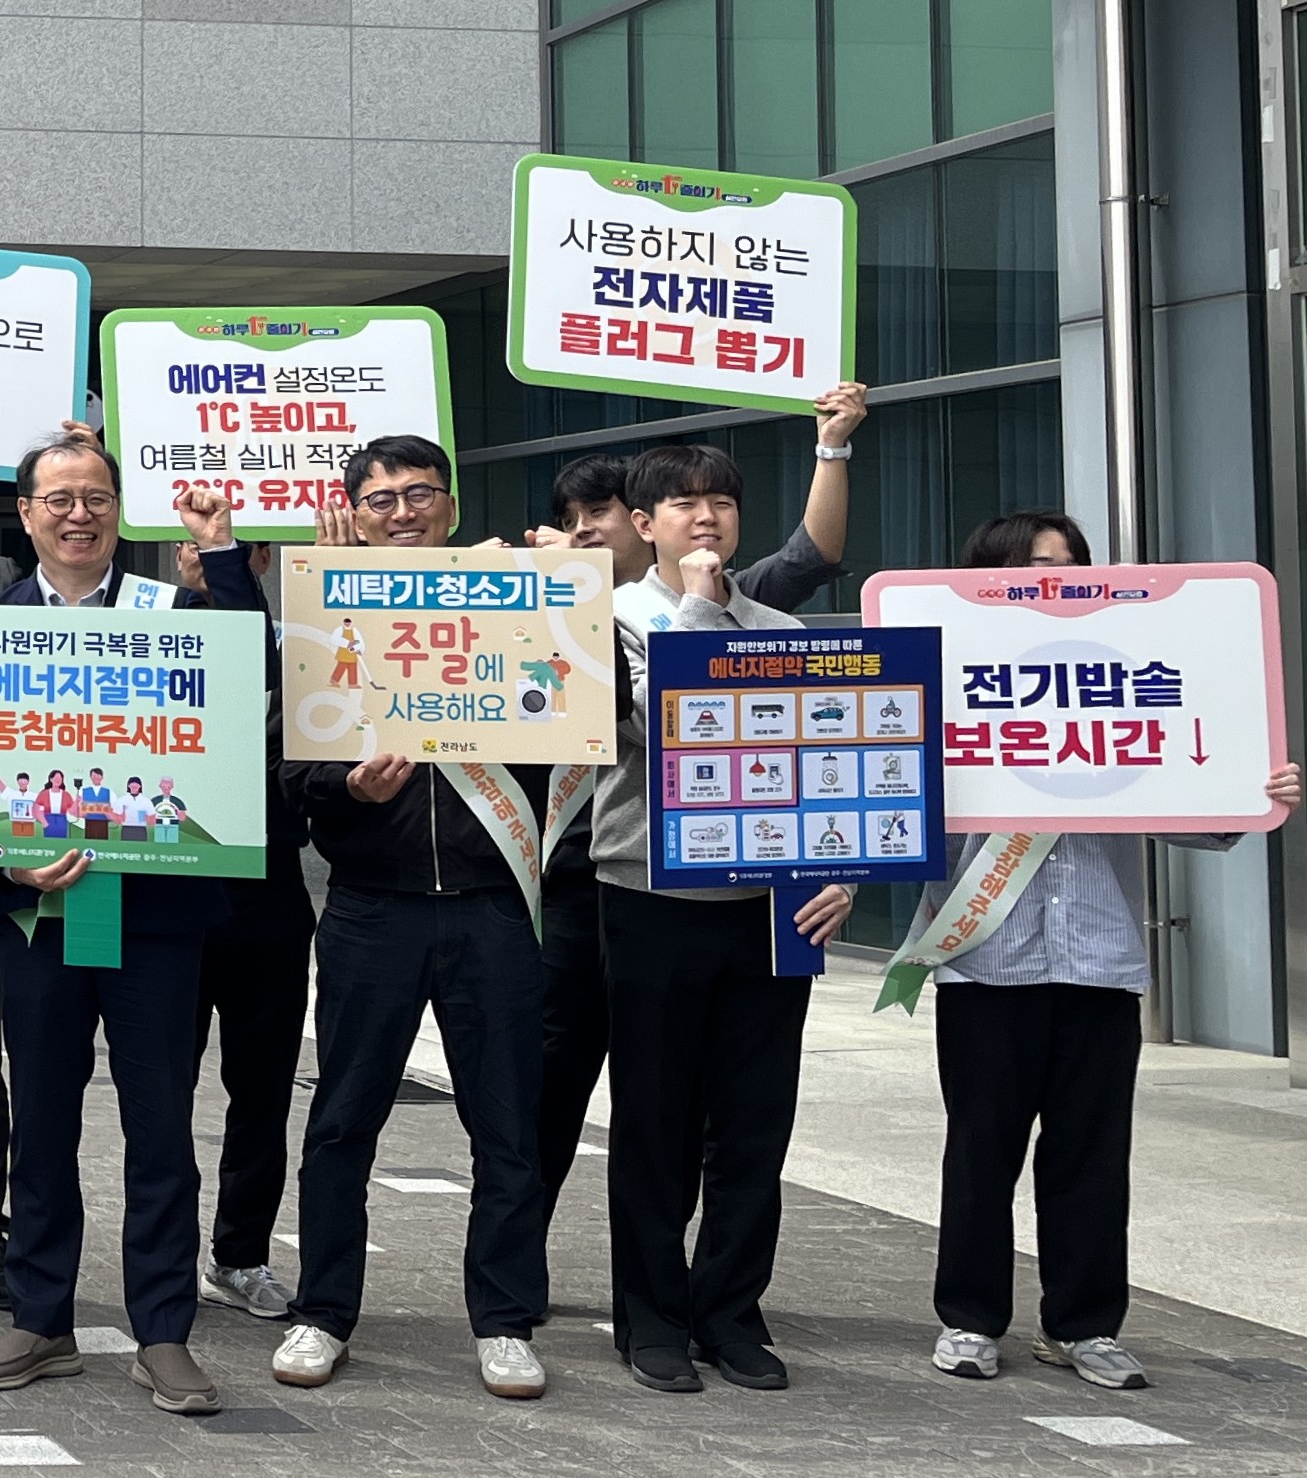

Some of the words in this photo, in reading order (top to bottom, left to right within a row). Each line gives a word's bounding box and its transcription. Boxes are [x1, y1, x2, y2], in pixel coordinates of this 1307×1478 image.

[560, 218, 715, 265] 사용하지
[735, 235, 809, 276] 않는
[592, 265, 775, 323] 전자제품
[560, 311, 695, 365] 플러그
[716, 328, 804, 378] 뽑기
[168, 363, 267, 394] 에어컨
[273, 366, 386, 393] 설정온도
[249, 402, 357, 434] 높이고,
[140, 444, 227, 471] 여름철
[237, 445, 295, 471] 실내
[306, 444, 363, 471] 적정
[258, 479, 349, 511] 유지하
[83, 632, 151, 658] 극복을
[158, 634, 204, 659] 위한
[384, 616, 504, 685] 주말에
[726, 640, 786, 653] 자원안보위기
[788, 640, 808, 652] 경보
[709, 657, 803, 679] 에너지절약
[806, 654, 881, 677] 국민행동
[963, 660, 1183, 709] 전기밥솥
[385, 692, 507, 722] 사용해요
[440, 741, 478, 753] 전라남도
[944, 719, 1166, 767] 보온시간
